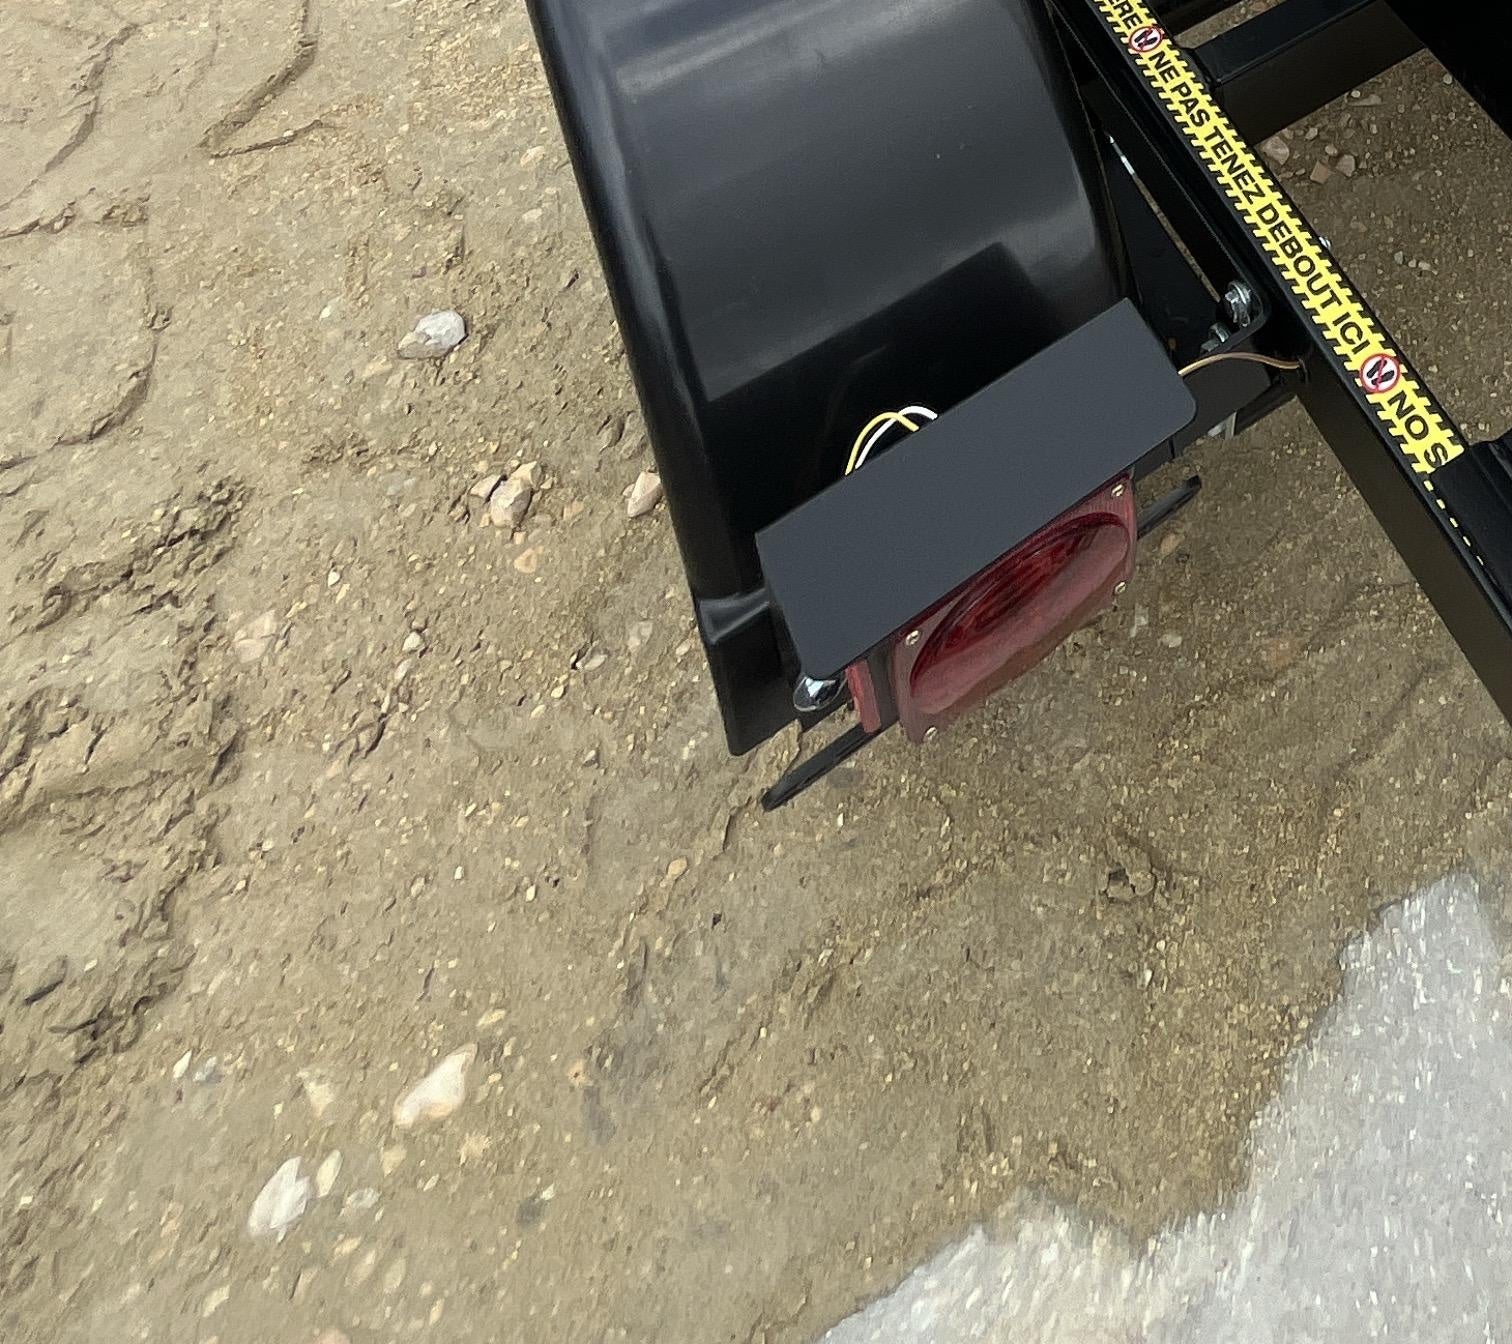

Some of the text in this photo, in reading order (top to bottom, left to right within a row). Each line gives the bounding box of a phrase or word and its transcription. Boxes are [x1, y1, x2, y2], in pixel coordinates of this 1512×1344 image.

[1150, 51, 1181, 88] NE
[1173, 84, 1211, 129] PAS
[1203, 127, 1267, 204] TENEZ
[1255, 206, 1342, 310] DEBOUT
[1331, 311, 1371, 356] ICI
[1389, 389, 1432, 443] NO
